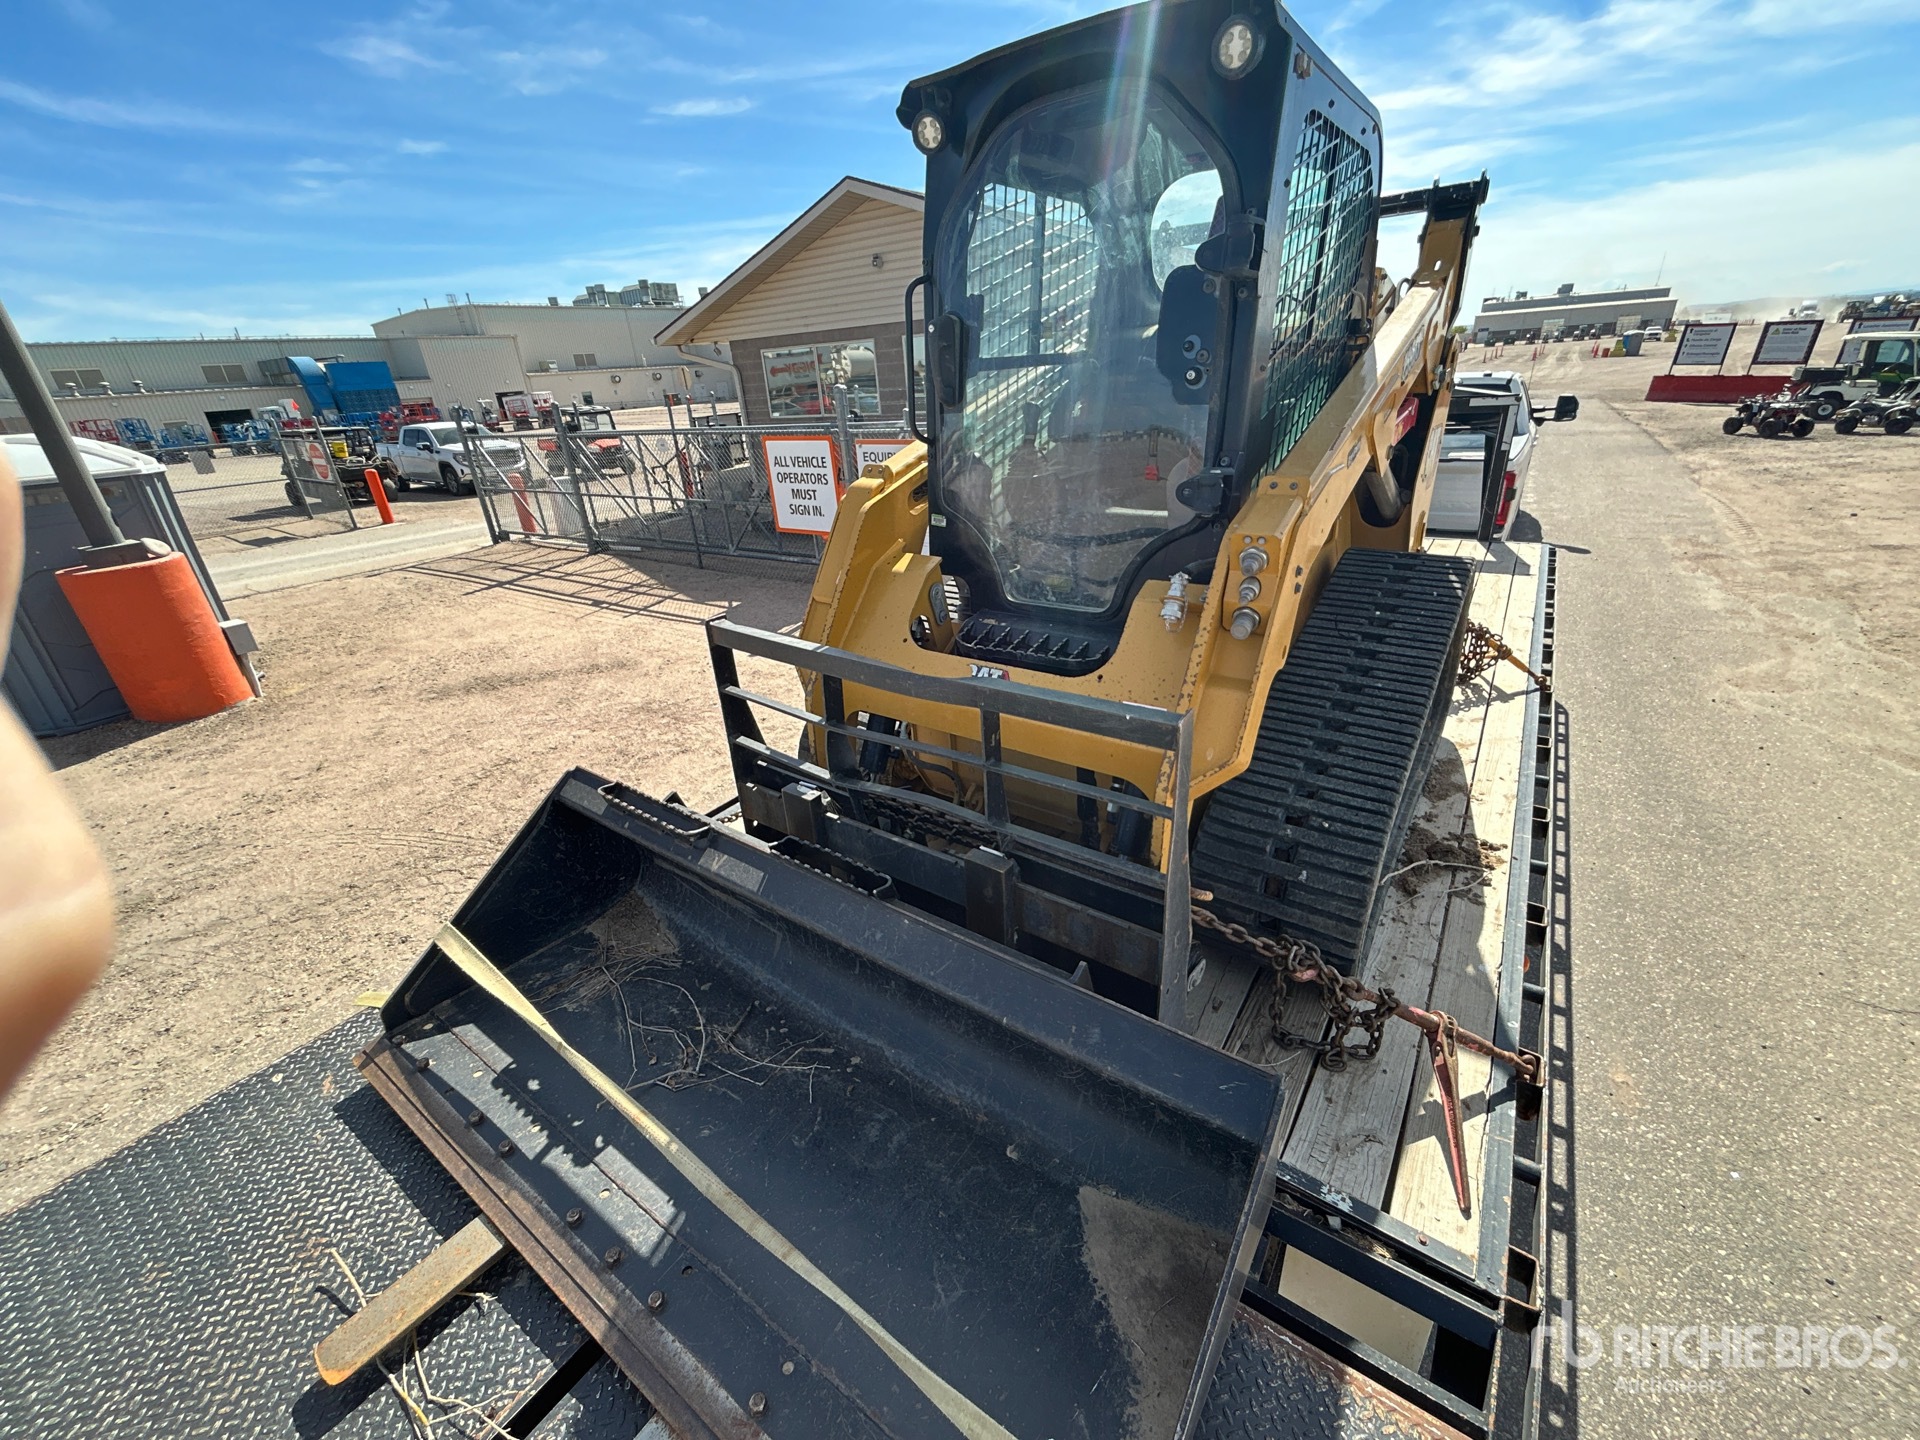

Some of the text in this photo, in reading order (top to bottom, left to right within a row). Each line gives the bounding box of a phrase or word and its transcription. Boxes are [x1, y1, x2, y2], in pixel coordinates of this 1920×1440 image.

[774, 456, 827, 468] ALL VEHICLE
[862, 451, 896, 463] EQUIP
[777, 472, 829, 485] OPERATORS
[791, 488, 817, 500] MUST
[789, 504, 825, 517] SIGN IN.
